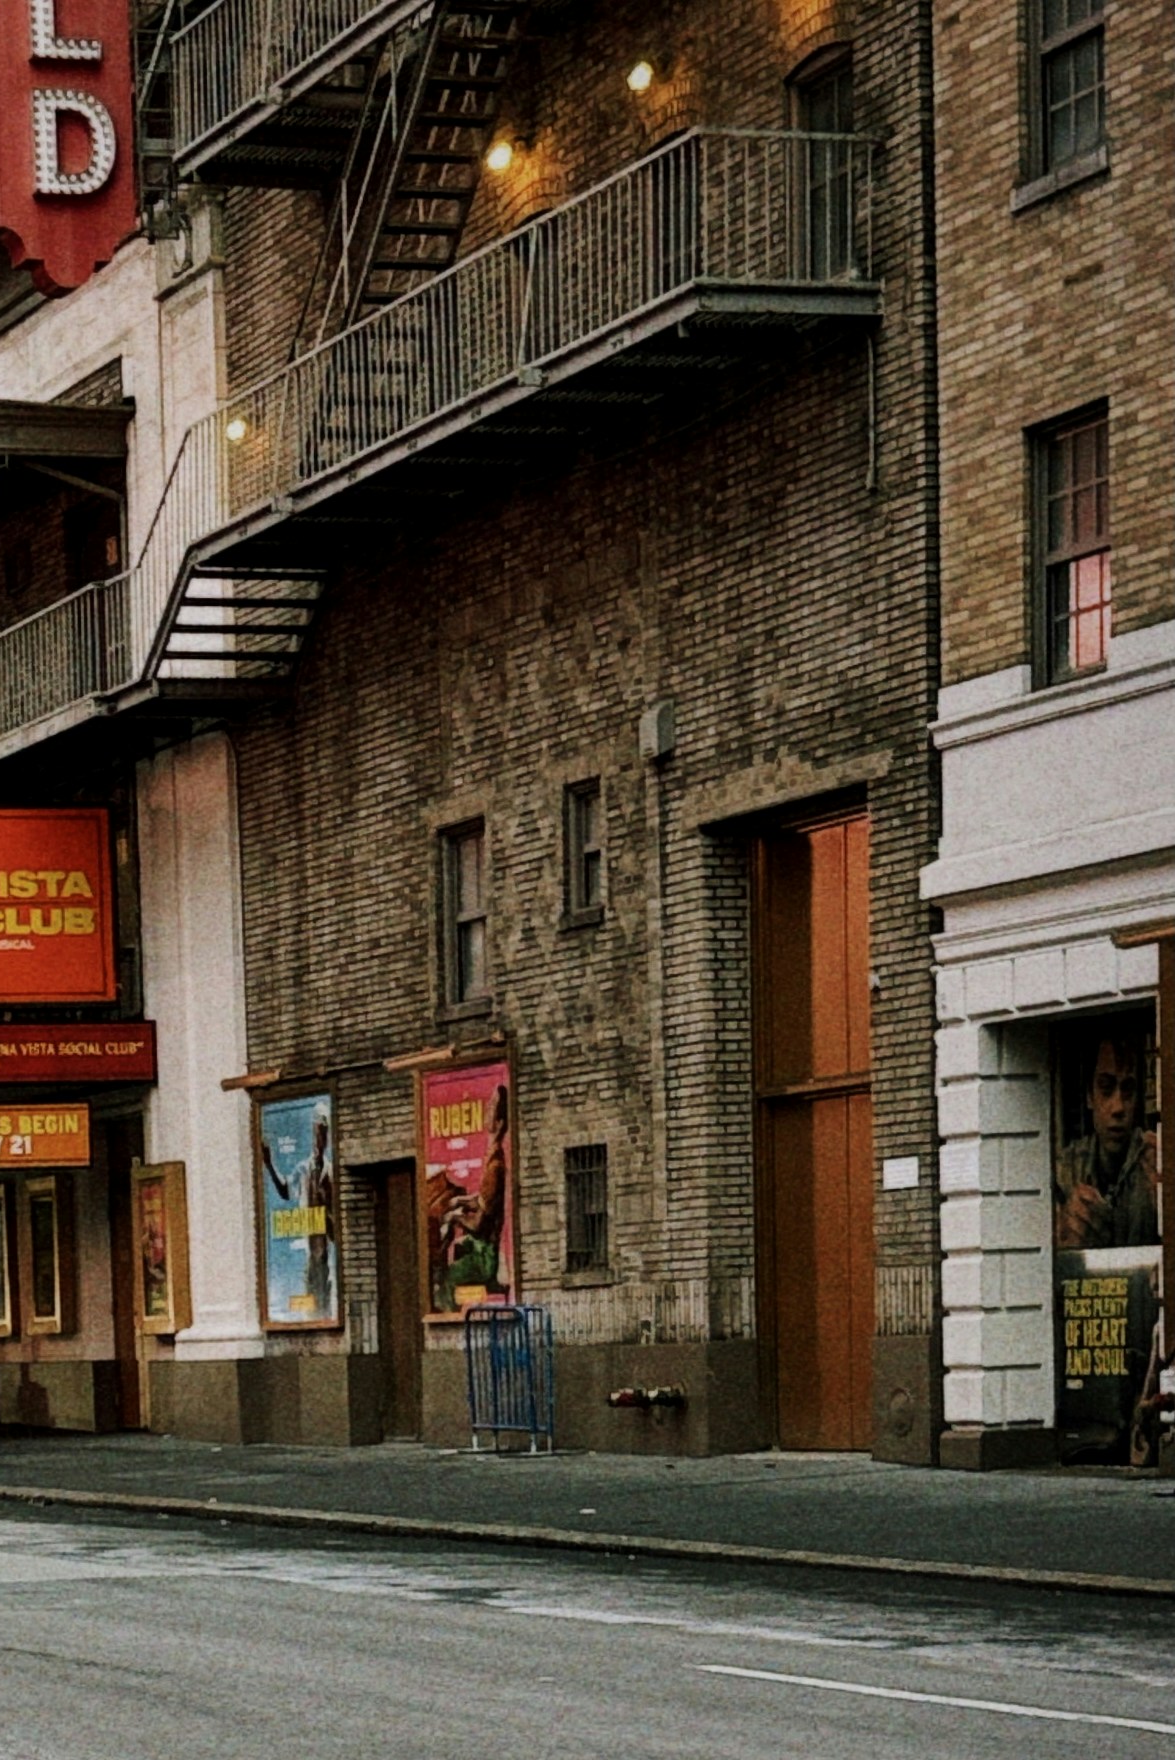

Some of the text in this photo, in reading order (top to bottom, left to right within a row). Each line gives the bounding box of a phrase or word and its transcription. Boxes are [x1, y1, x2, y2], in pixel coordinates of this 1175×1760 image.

[20, 1043, 55, 1056] VISTA
[58, 1042, 102, 1056] SOCIAL
[18, 1114, 79, 1135] BEGIN
[9, 1136, 33, 1155] 21
[1092, 1297, 1129, 1318] PLENTY
[1065, 1318, 1128, 1347] OF HEART
[1065, 1348, 1092, 1376] AND
